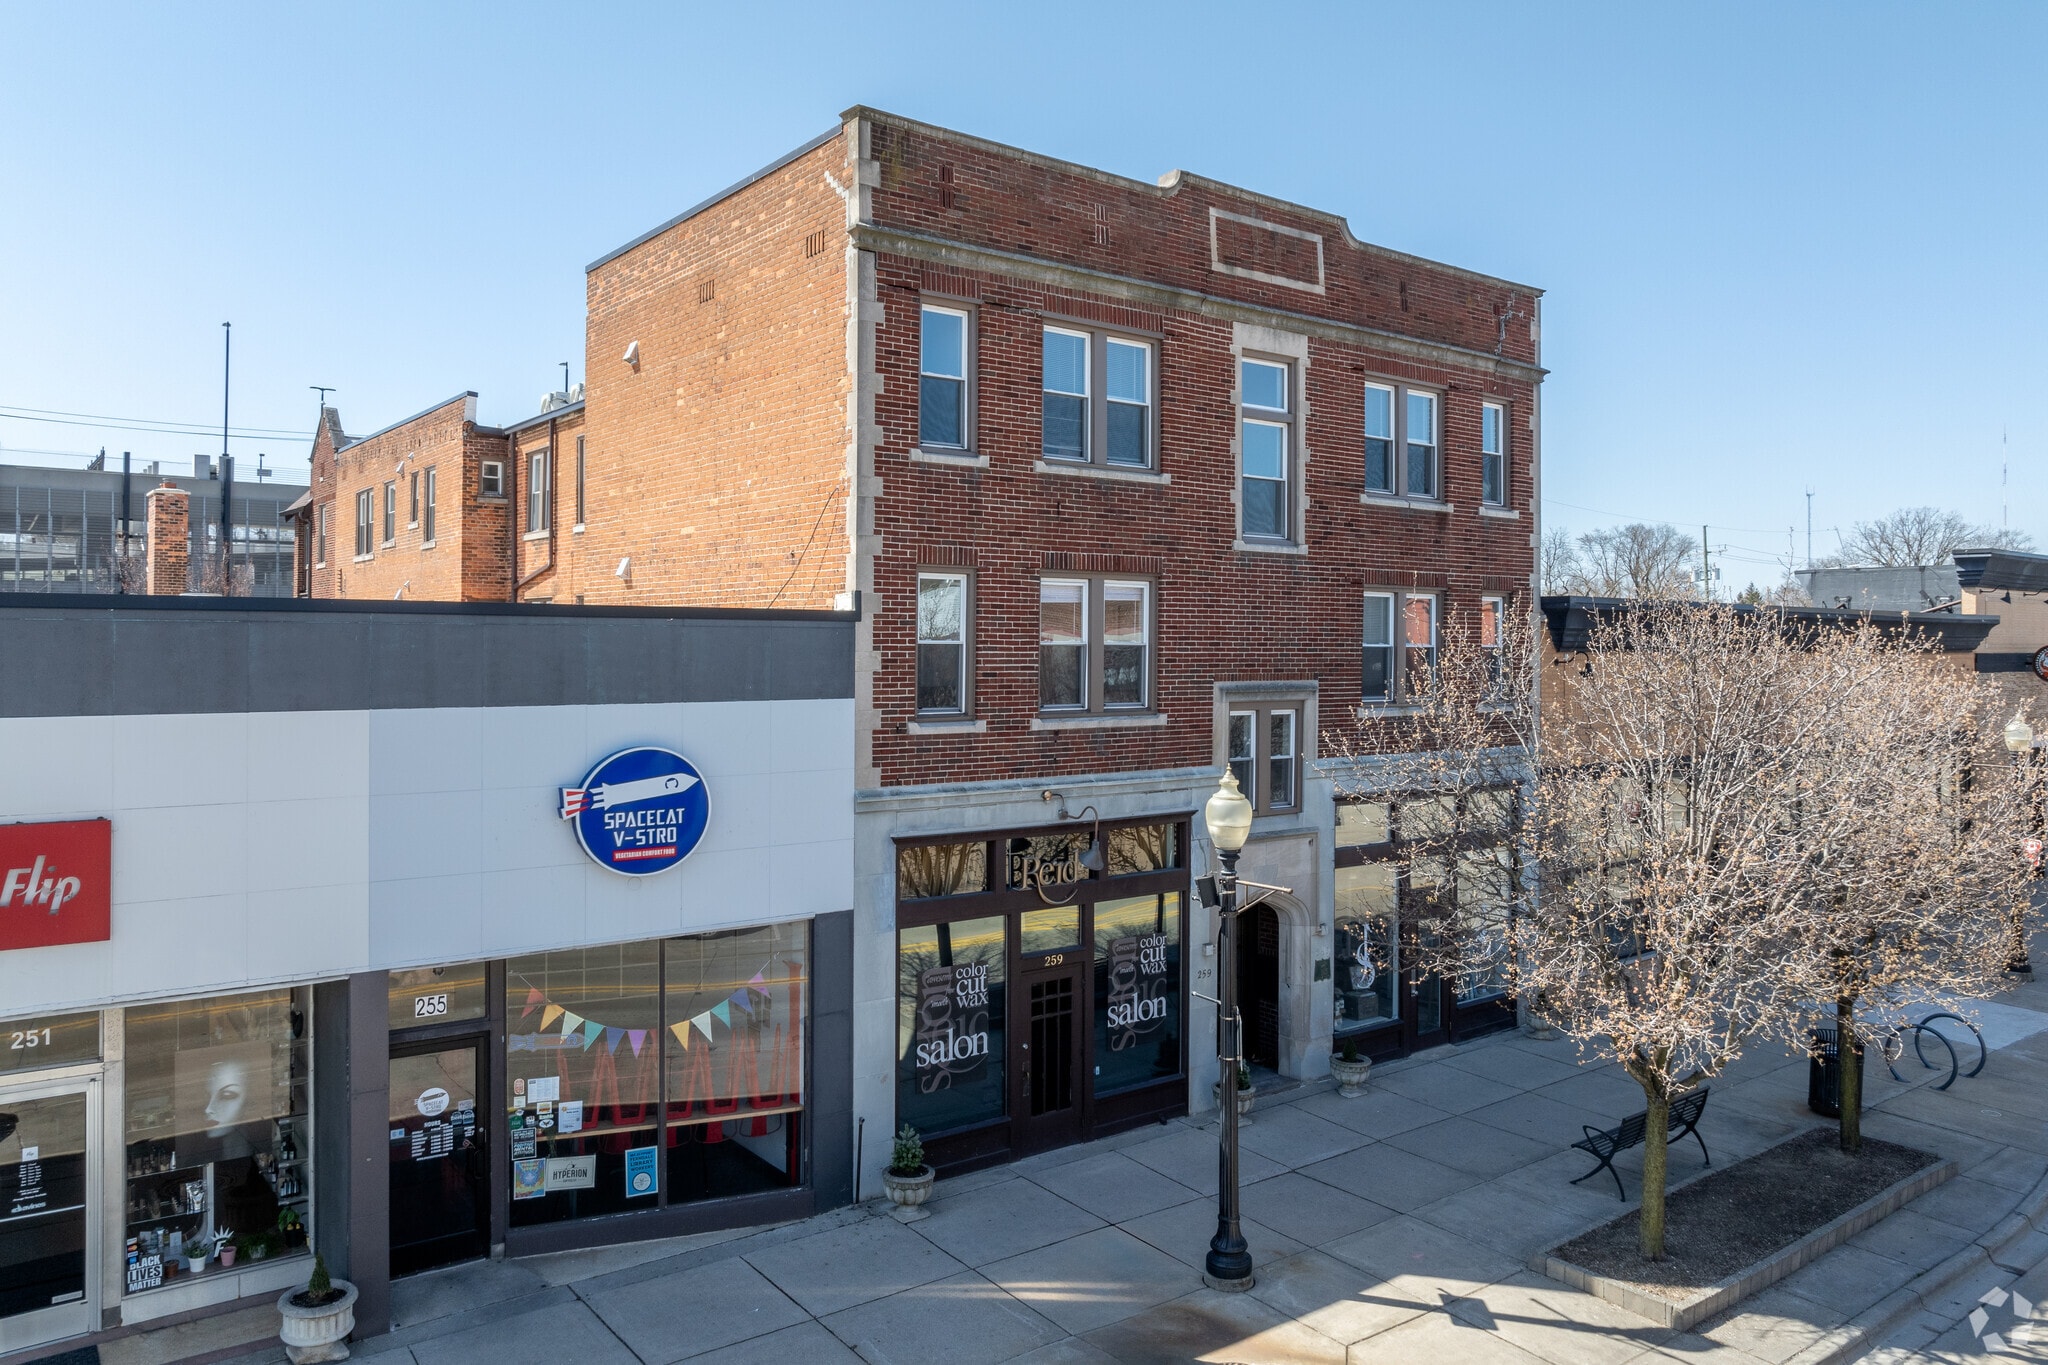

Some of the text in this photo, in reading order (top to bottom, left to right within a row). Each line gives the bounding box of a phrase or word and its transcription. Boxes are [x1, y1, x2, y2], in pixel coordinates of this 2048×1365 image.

[604, 808, 685, 829] SPACECAT
[613, 827, 677, 847] V-STRO
[0, 855, 81, 915] Flip
[1012, 848, 1079, 905] Reid
[1140, 934, 1167, 948] color
[1044, 954, 1064, 967] 259
[1140, 944, 1166, 964] cut
[956, 963, 989, 979] color
[1140, 960, 1167, 975] wax
[1197, 968, 1212, 980] 259
[956, 973, 987, 996] cut
[416, 995, 446, 1017] 255
[957, 991, 989, 1009] wax
[1108, 992, 1167, 1028] salon
[11, 1028, 51, 1050] 251
[916, 1027, 989, 1068] salon
[553, 1169, 588, 1181] HYPERION
[130, 1255, 161, 1271] BLACK
[128, 1266, 162, 1283] LIVES
[129, 1278, 161, 1292] MATTER
